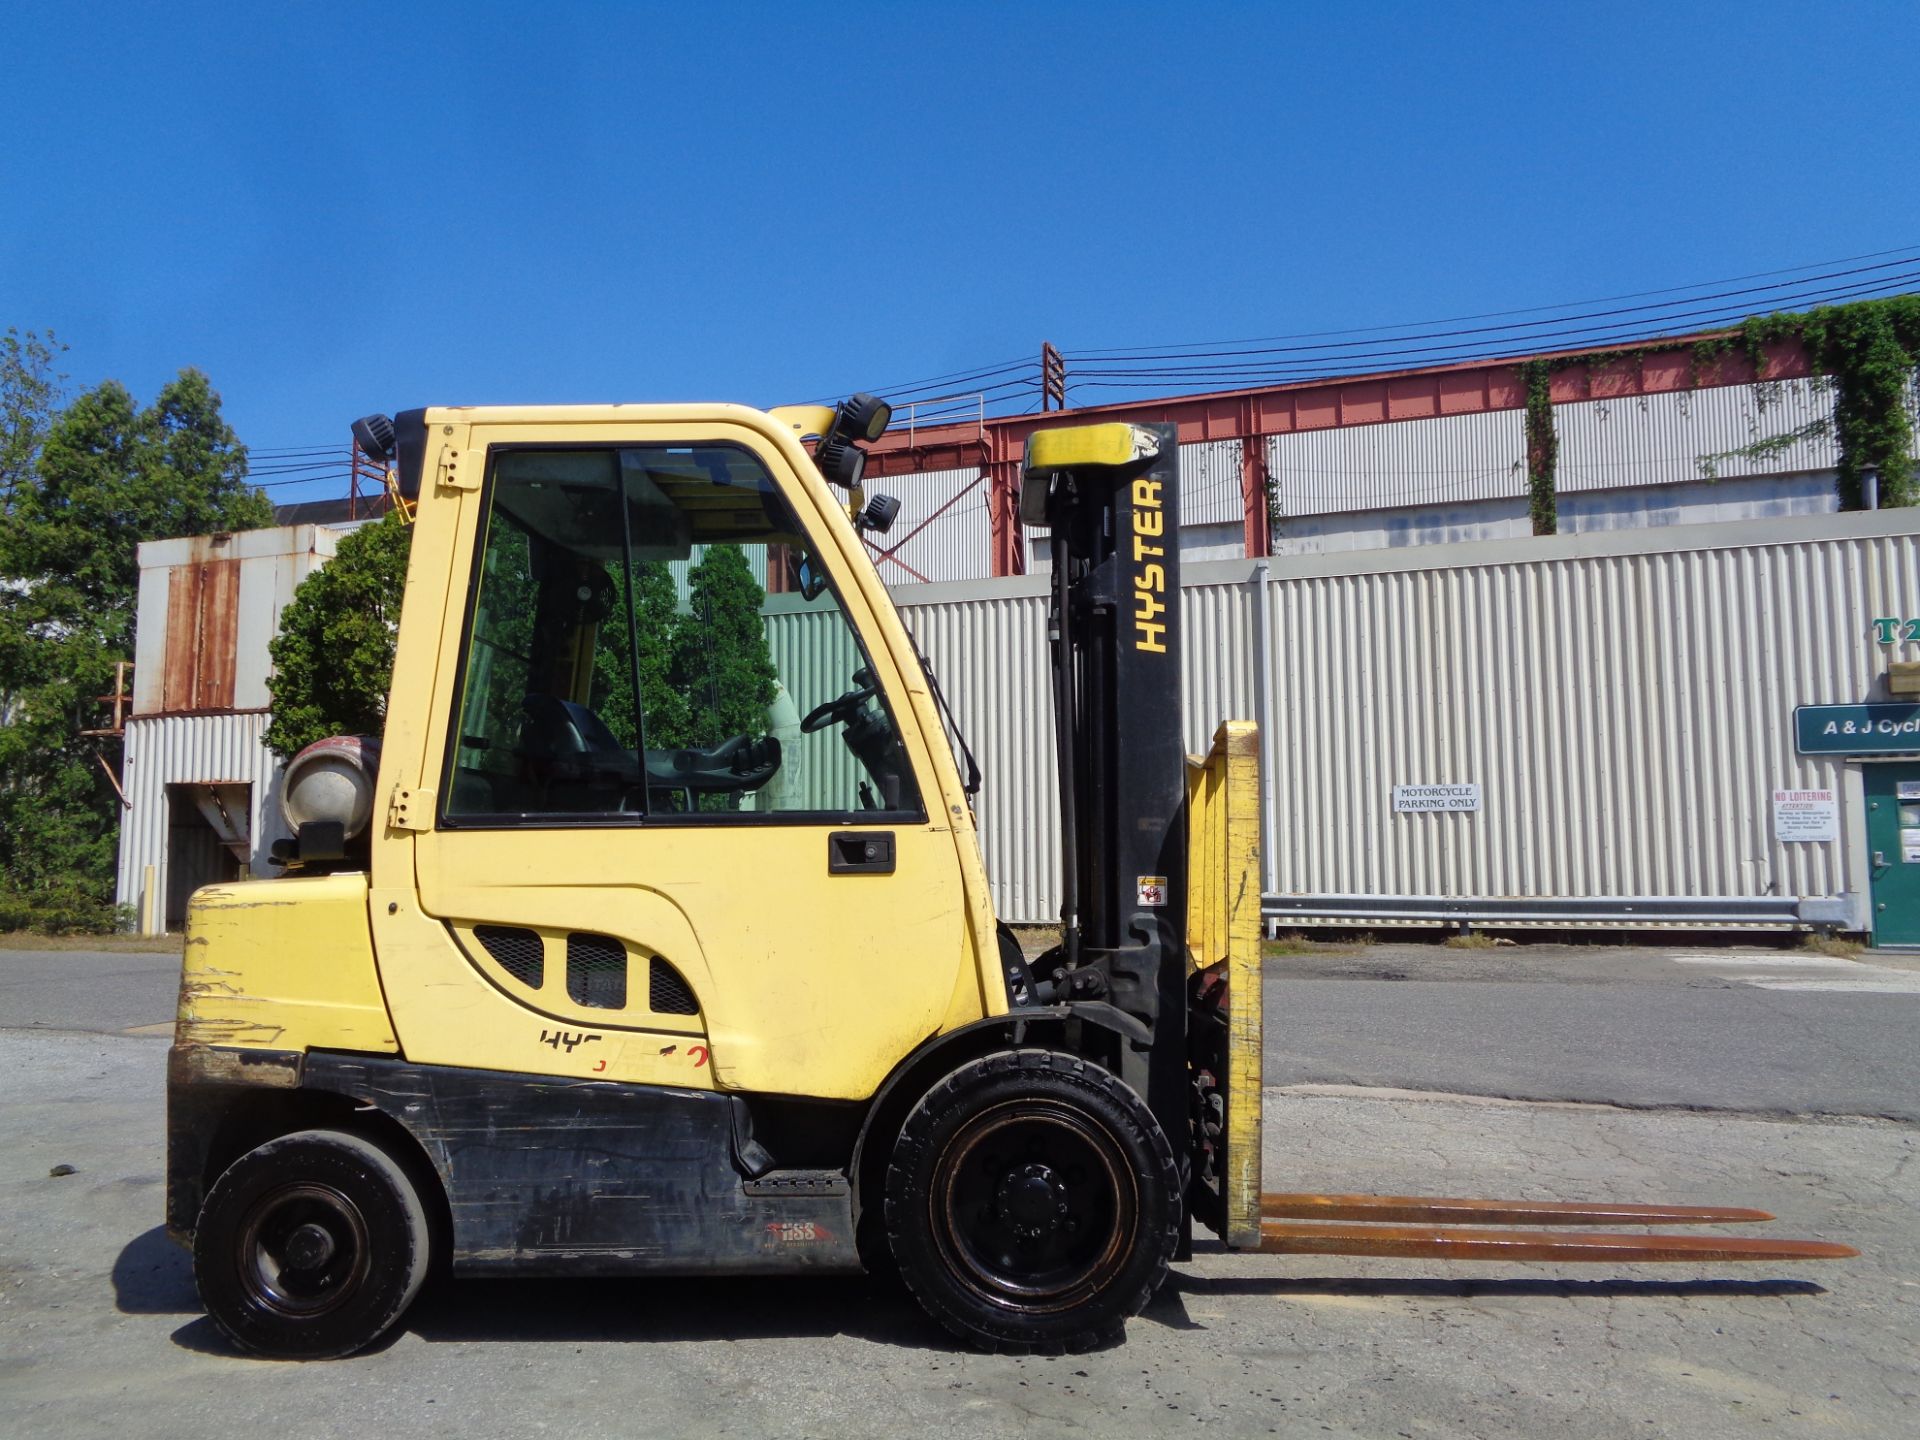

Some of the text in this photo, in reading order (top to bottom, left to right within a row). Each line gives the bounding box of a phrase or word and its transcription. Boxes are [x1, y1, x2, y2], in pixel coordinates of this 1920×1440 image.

[1132, 479, 1166, 653] HYSTER
[1823, 721, 1838, 735] A
[1843, 720, 1857, 734] &
[1861, 720, 1872, 734] J
[1401, 787, 1472, 797] MOTORCYCLE
[1775, 791, 1832, 801] NO LOITERING
[1399, 799, 1476, 809] PARKING ONLY
